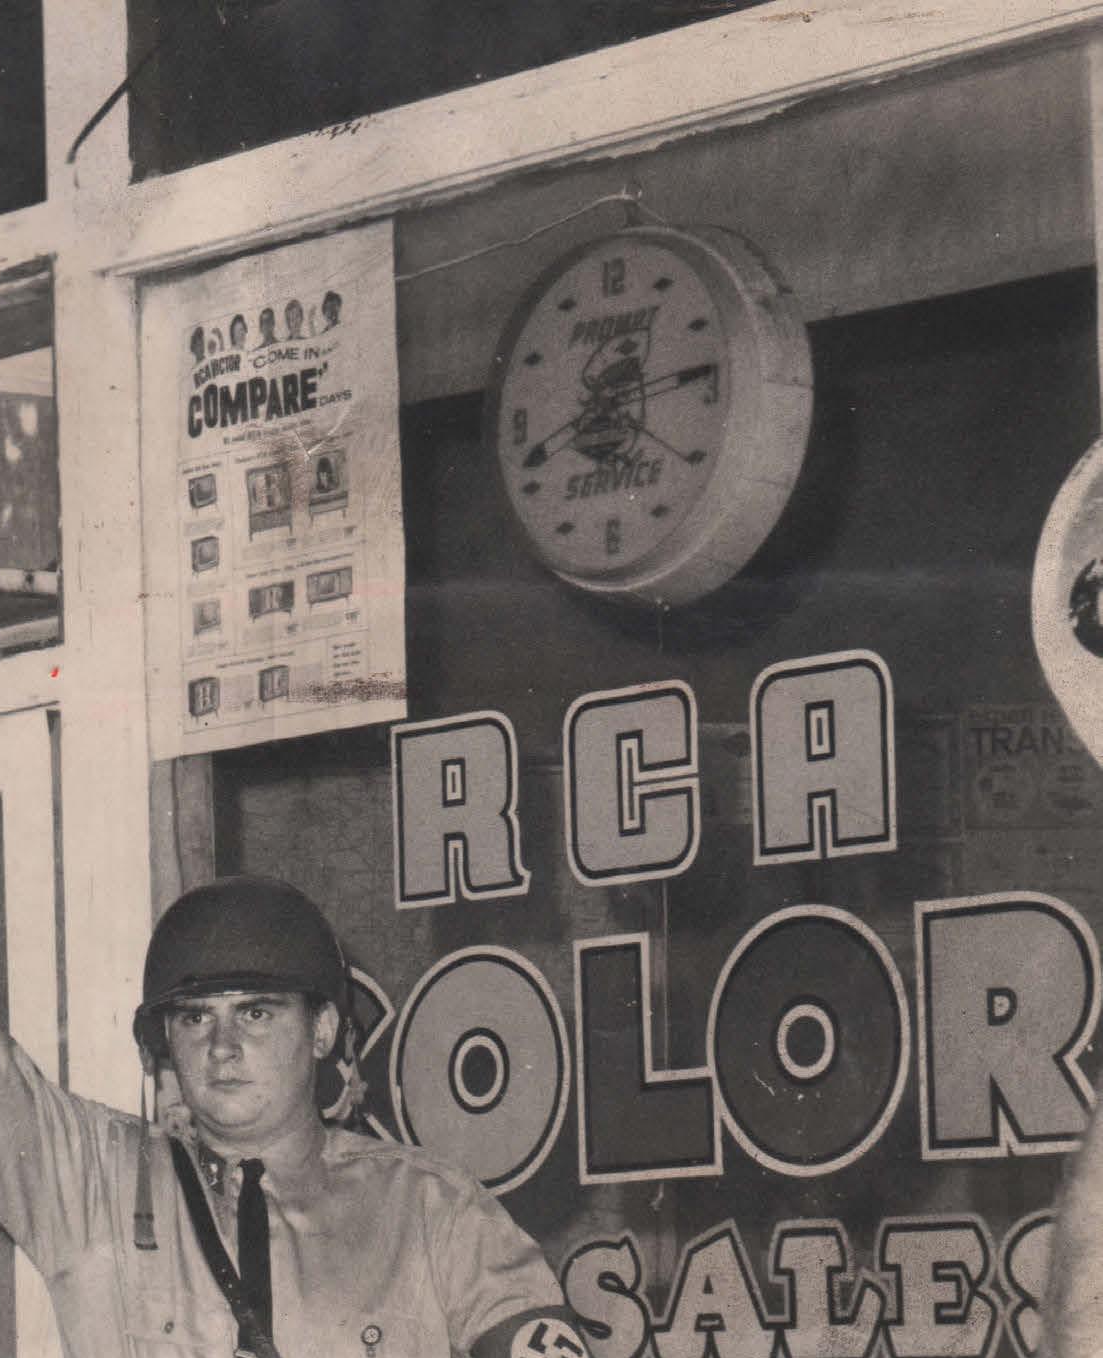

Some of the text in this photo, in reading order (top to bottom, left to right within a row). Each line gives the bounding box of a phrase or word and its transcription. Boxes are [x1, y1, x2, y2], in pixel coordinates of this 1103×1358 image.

[602, 257, 626, 298] 12
[210, 354, 241, 379] VICTOR
[390, 648, 897, 911] RCA
